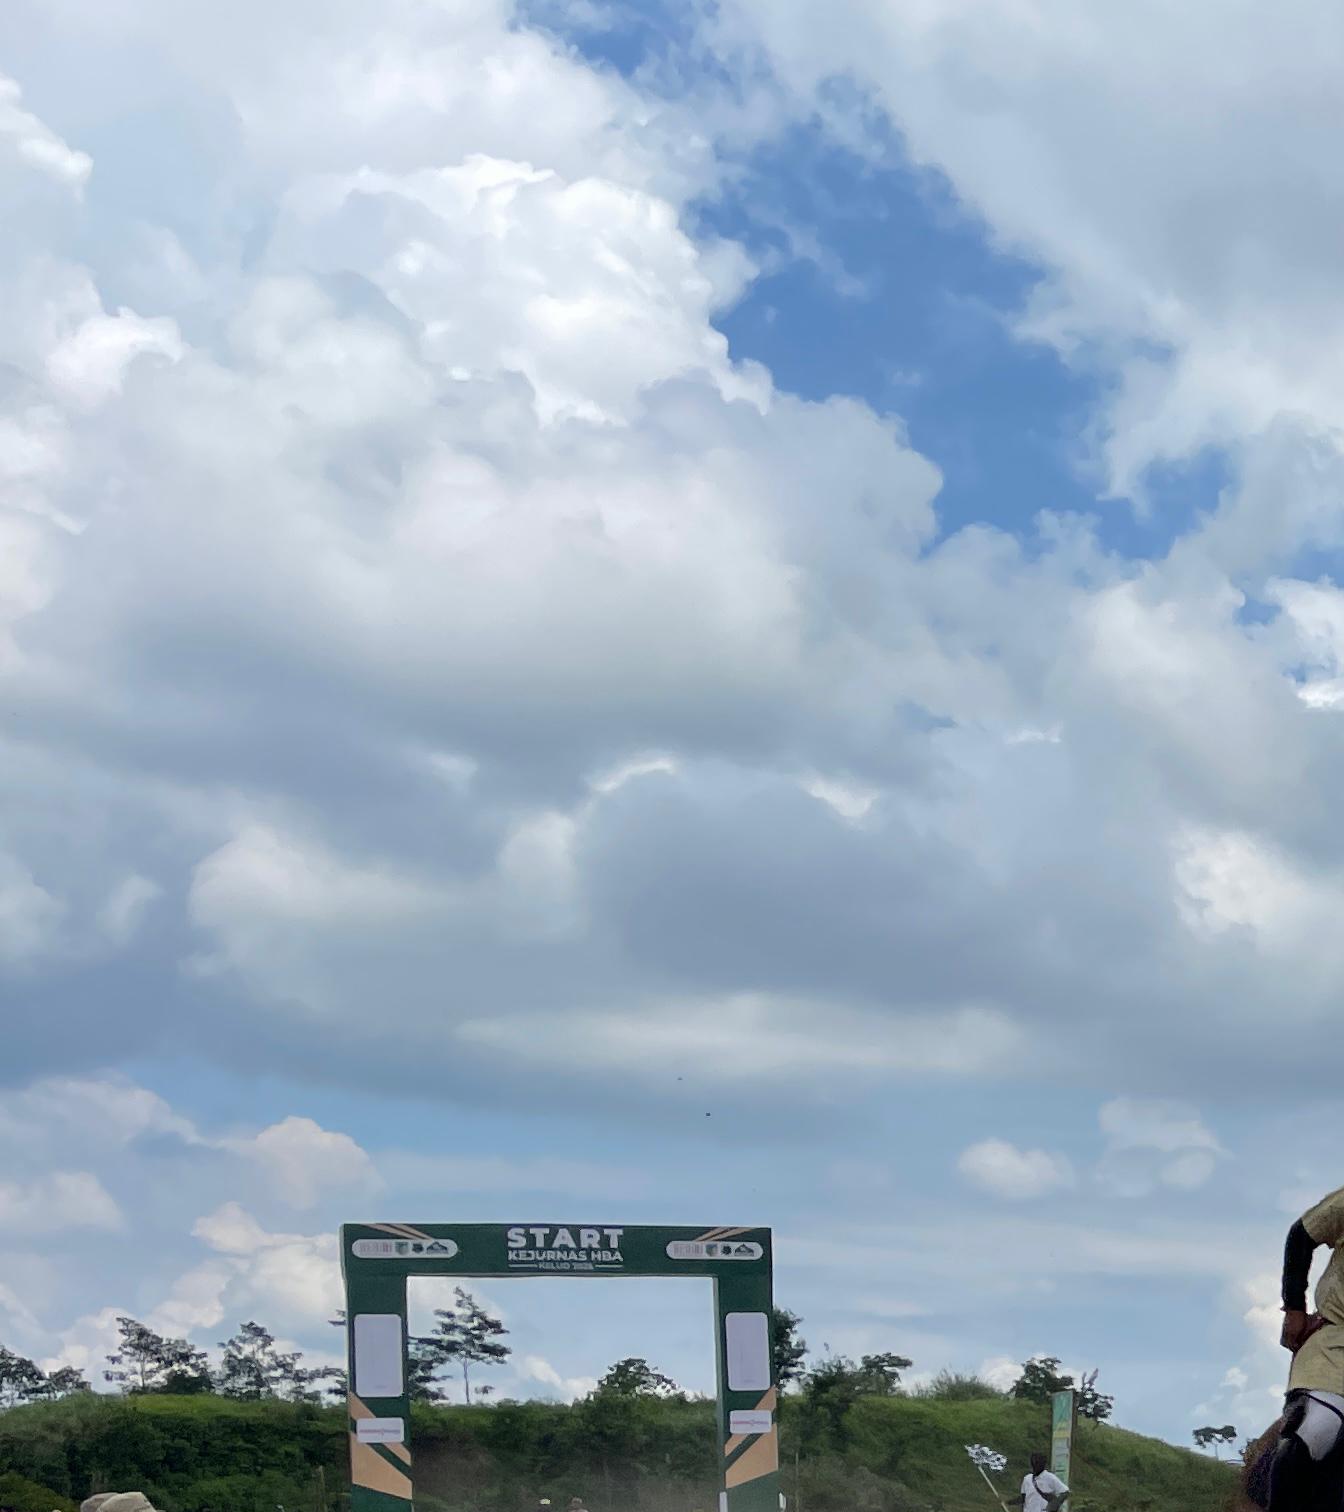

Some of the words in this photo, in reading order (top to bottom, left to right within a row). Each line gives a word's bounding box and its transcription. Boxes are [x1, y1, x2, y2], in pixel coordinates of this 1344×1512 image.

[507, 1227, 624, 1248] START
[508, 1249, 587, 1261] KEJURNAS
[591, 1250, 624, 1262] HBA
